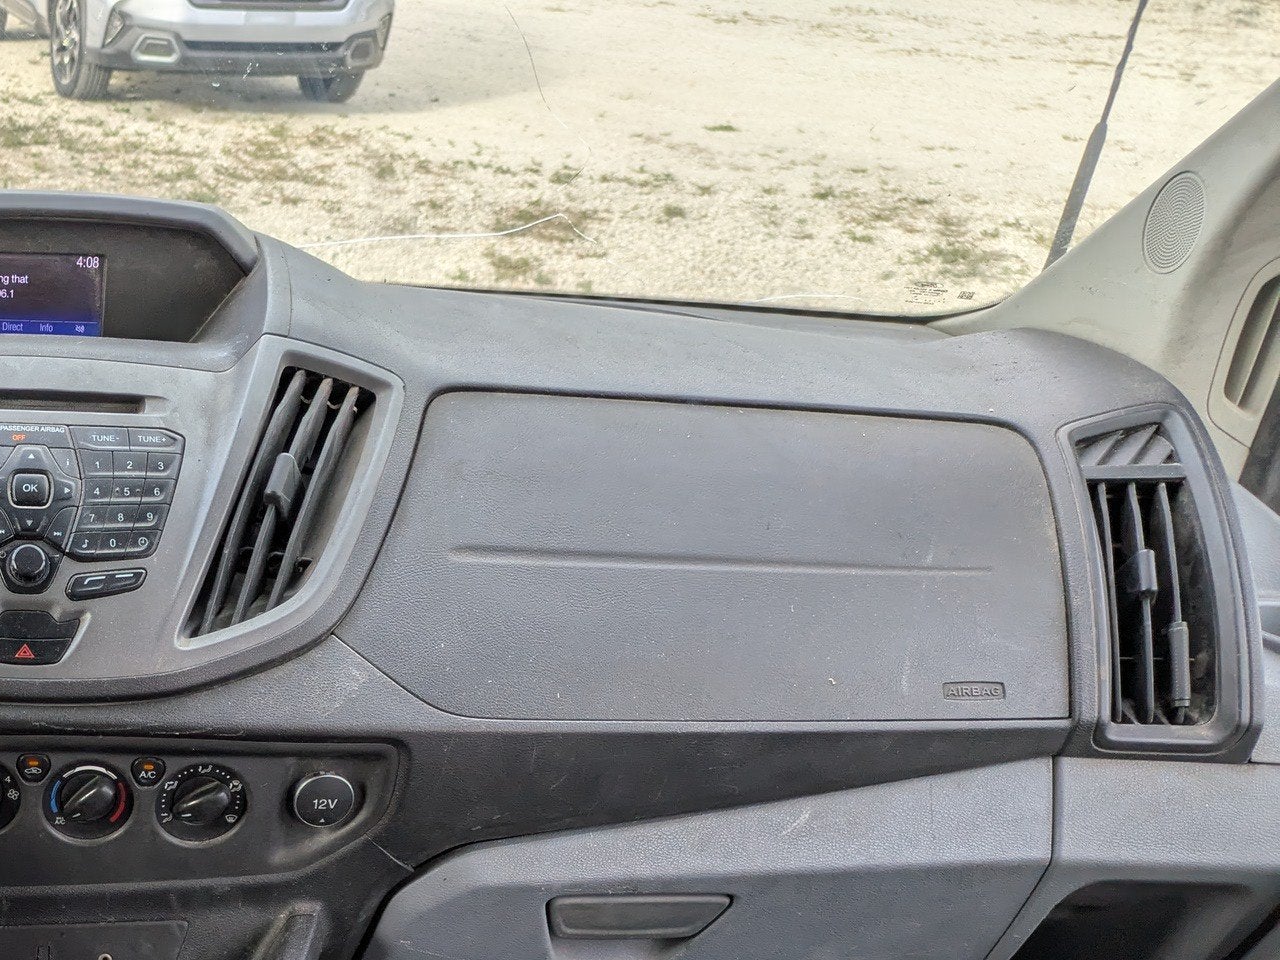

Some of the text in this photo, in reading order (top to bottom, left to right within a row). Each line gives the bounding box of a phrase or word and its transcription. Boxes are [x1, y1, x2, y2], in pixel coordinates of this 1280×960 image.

[76, 257, 99, 268] 4:08
[11, 274, 29, 284] that
[2, 322, 23, 332] Direct
[40, 323, 53, 332] Info
[95, 461, 100, 469] 1
[127, 461, 133, 469] 2
[157, 462, 164, 470] 3
[22, 483, 38, 493] OK
[93, 488, 100, 496] 4
[124, 487, 130, 496] 5
[154, 488, 160, 496] 6
[89, 513, 95, 522] 7
[118, 513, 124, 522] 8
[147, 512, 154, 521] 9
[109, 539, 116, 548] 0
[946, 686, 1000, 697] AIRBAG
[4, 775, 11, 783] 4
[139, 771, 156, 780] A/C
[313, 798, 338, 810] 12V
